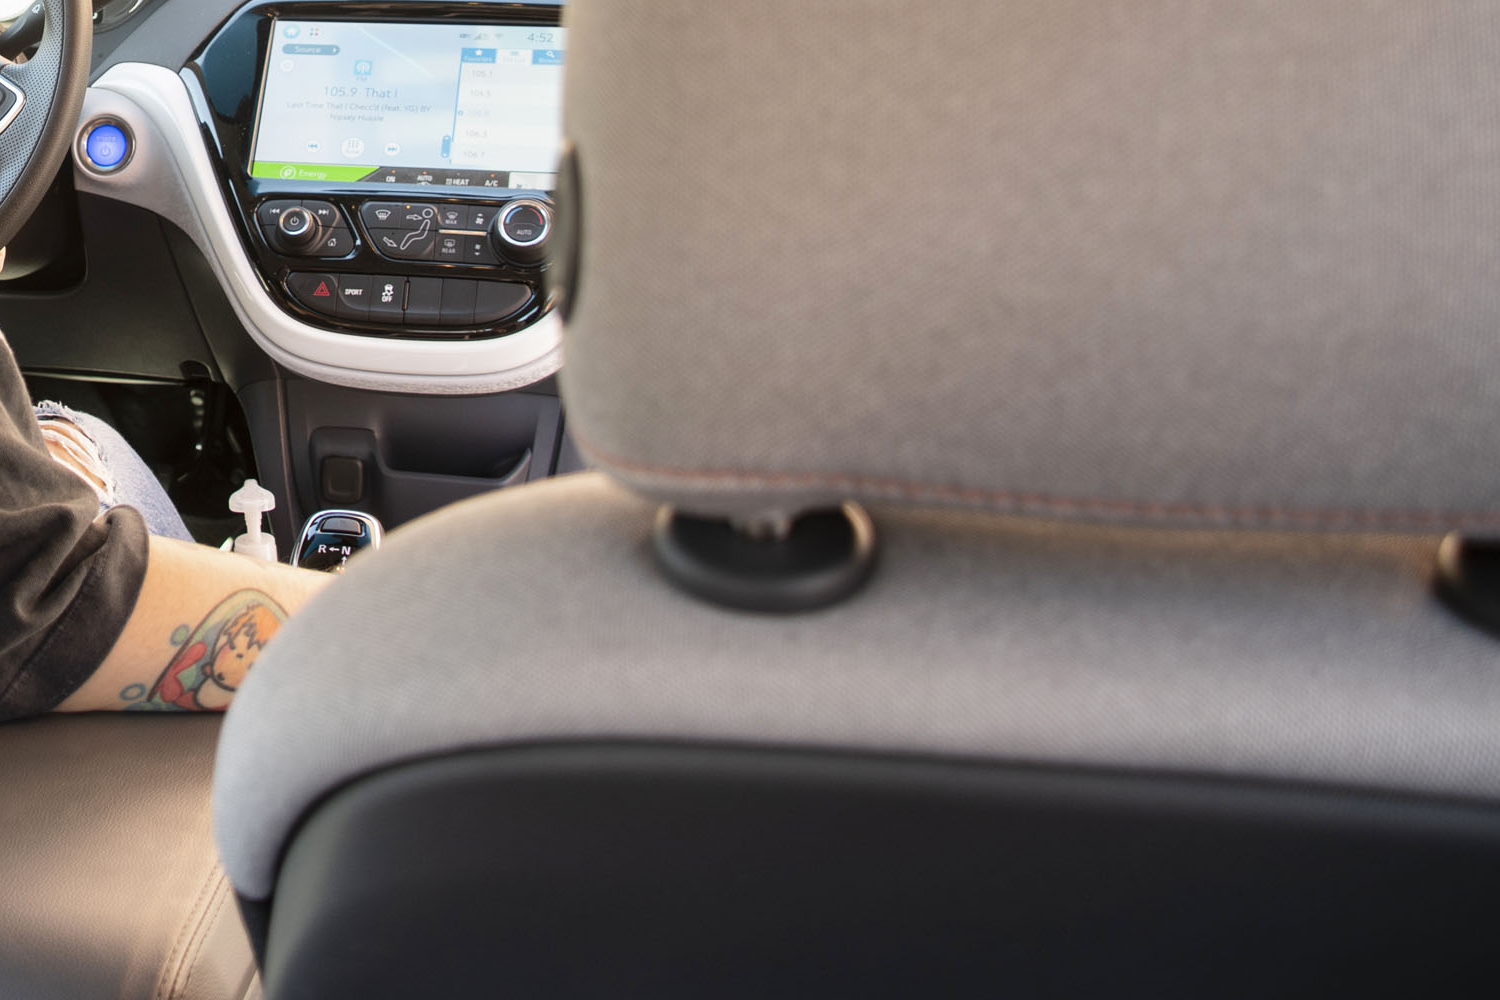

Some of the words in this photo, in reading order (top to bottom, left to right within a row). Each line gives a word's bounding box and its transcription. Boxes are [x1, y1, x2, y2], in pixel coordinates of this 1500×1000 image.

[527, 32, 554, 43] 4:52
[324, 86, 359, 98] 105.9
[364, 87, 393, 99] That
[298, 169, 328, 180] Energy
[416, 174, 433, 182] AUTO
[452, 178, 470, 186] HEAT
[484, 179, 499, 187] A/C
[344, 288, 364, 296] SPORT
[317, 544, 327, 553] R
[341, 545, 351, 556] N
